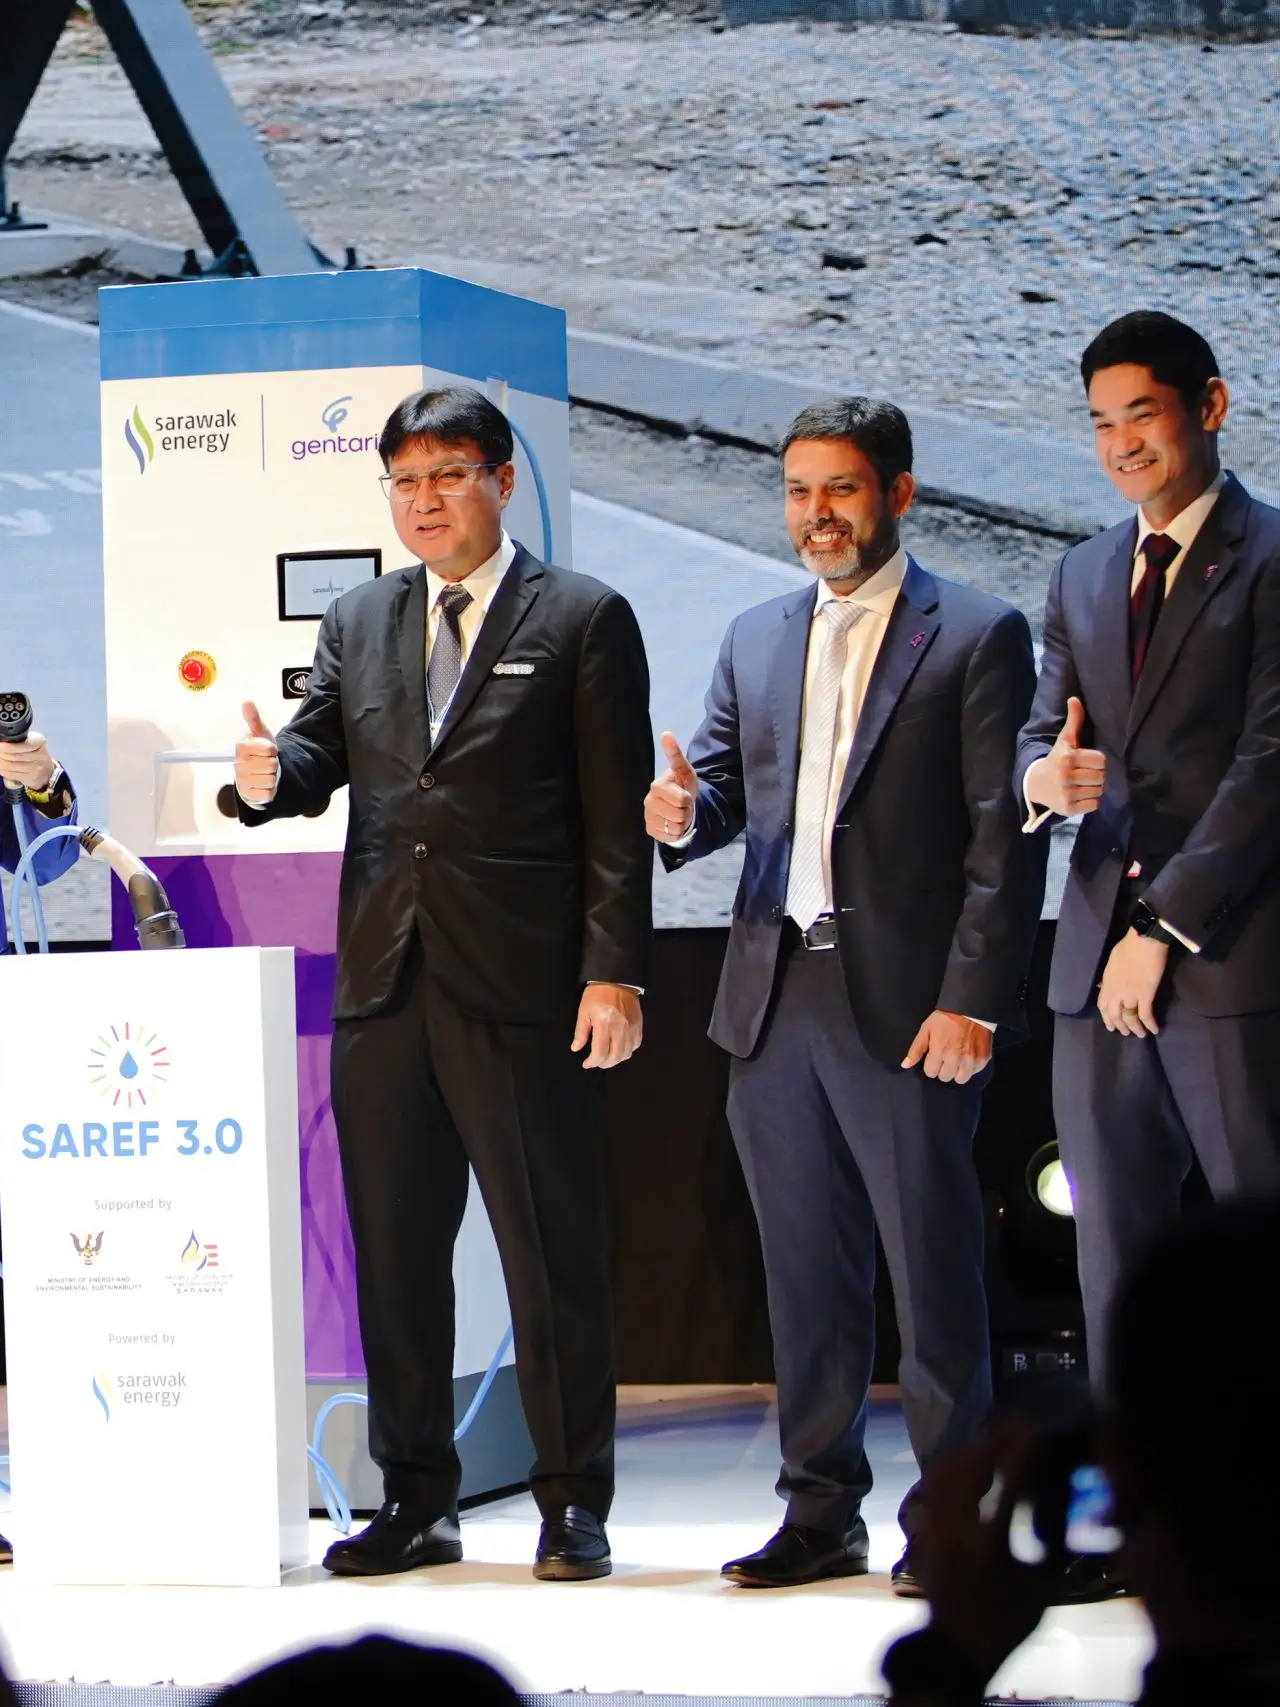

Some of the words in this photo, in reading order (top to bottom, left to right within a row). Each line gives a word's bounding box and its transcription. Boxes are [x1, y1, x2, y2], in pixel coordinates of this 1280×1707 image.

[155, 409, 237, 431] sarawak
[162, 433, 229, 452] energy
[291, 434, 378, 460] gentari
[22, 1121, 159, 1159] SAREF
[176, 1118, 243, 1155] 3.0
[95, 1199, 153, 1211] Supported
[158, 1198, 171, 1210] by
[108, 1332, 158, 1344] Powered
[163, 1333, 176, 1346] by
[117, 1372, 187, 1387] sarawak
[123, 1391, 181, 1407] energy
